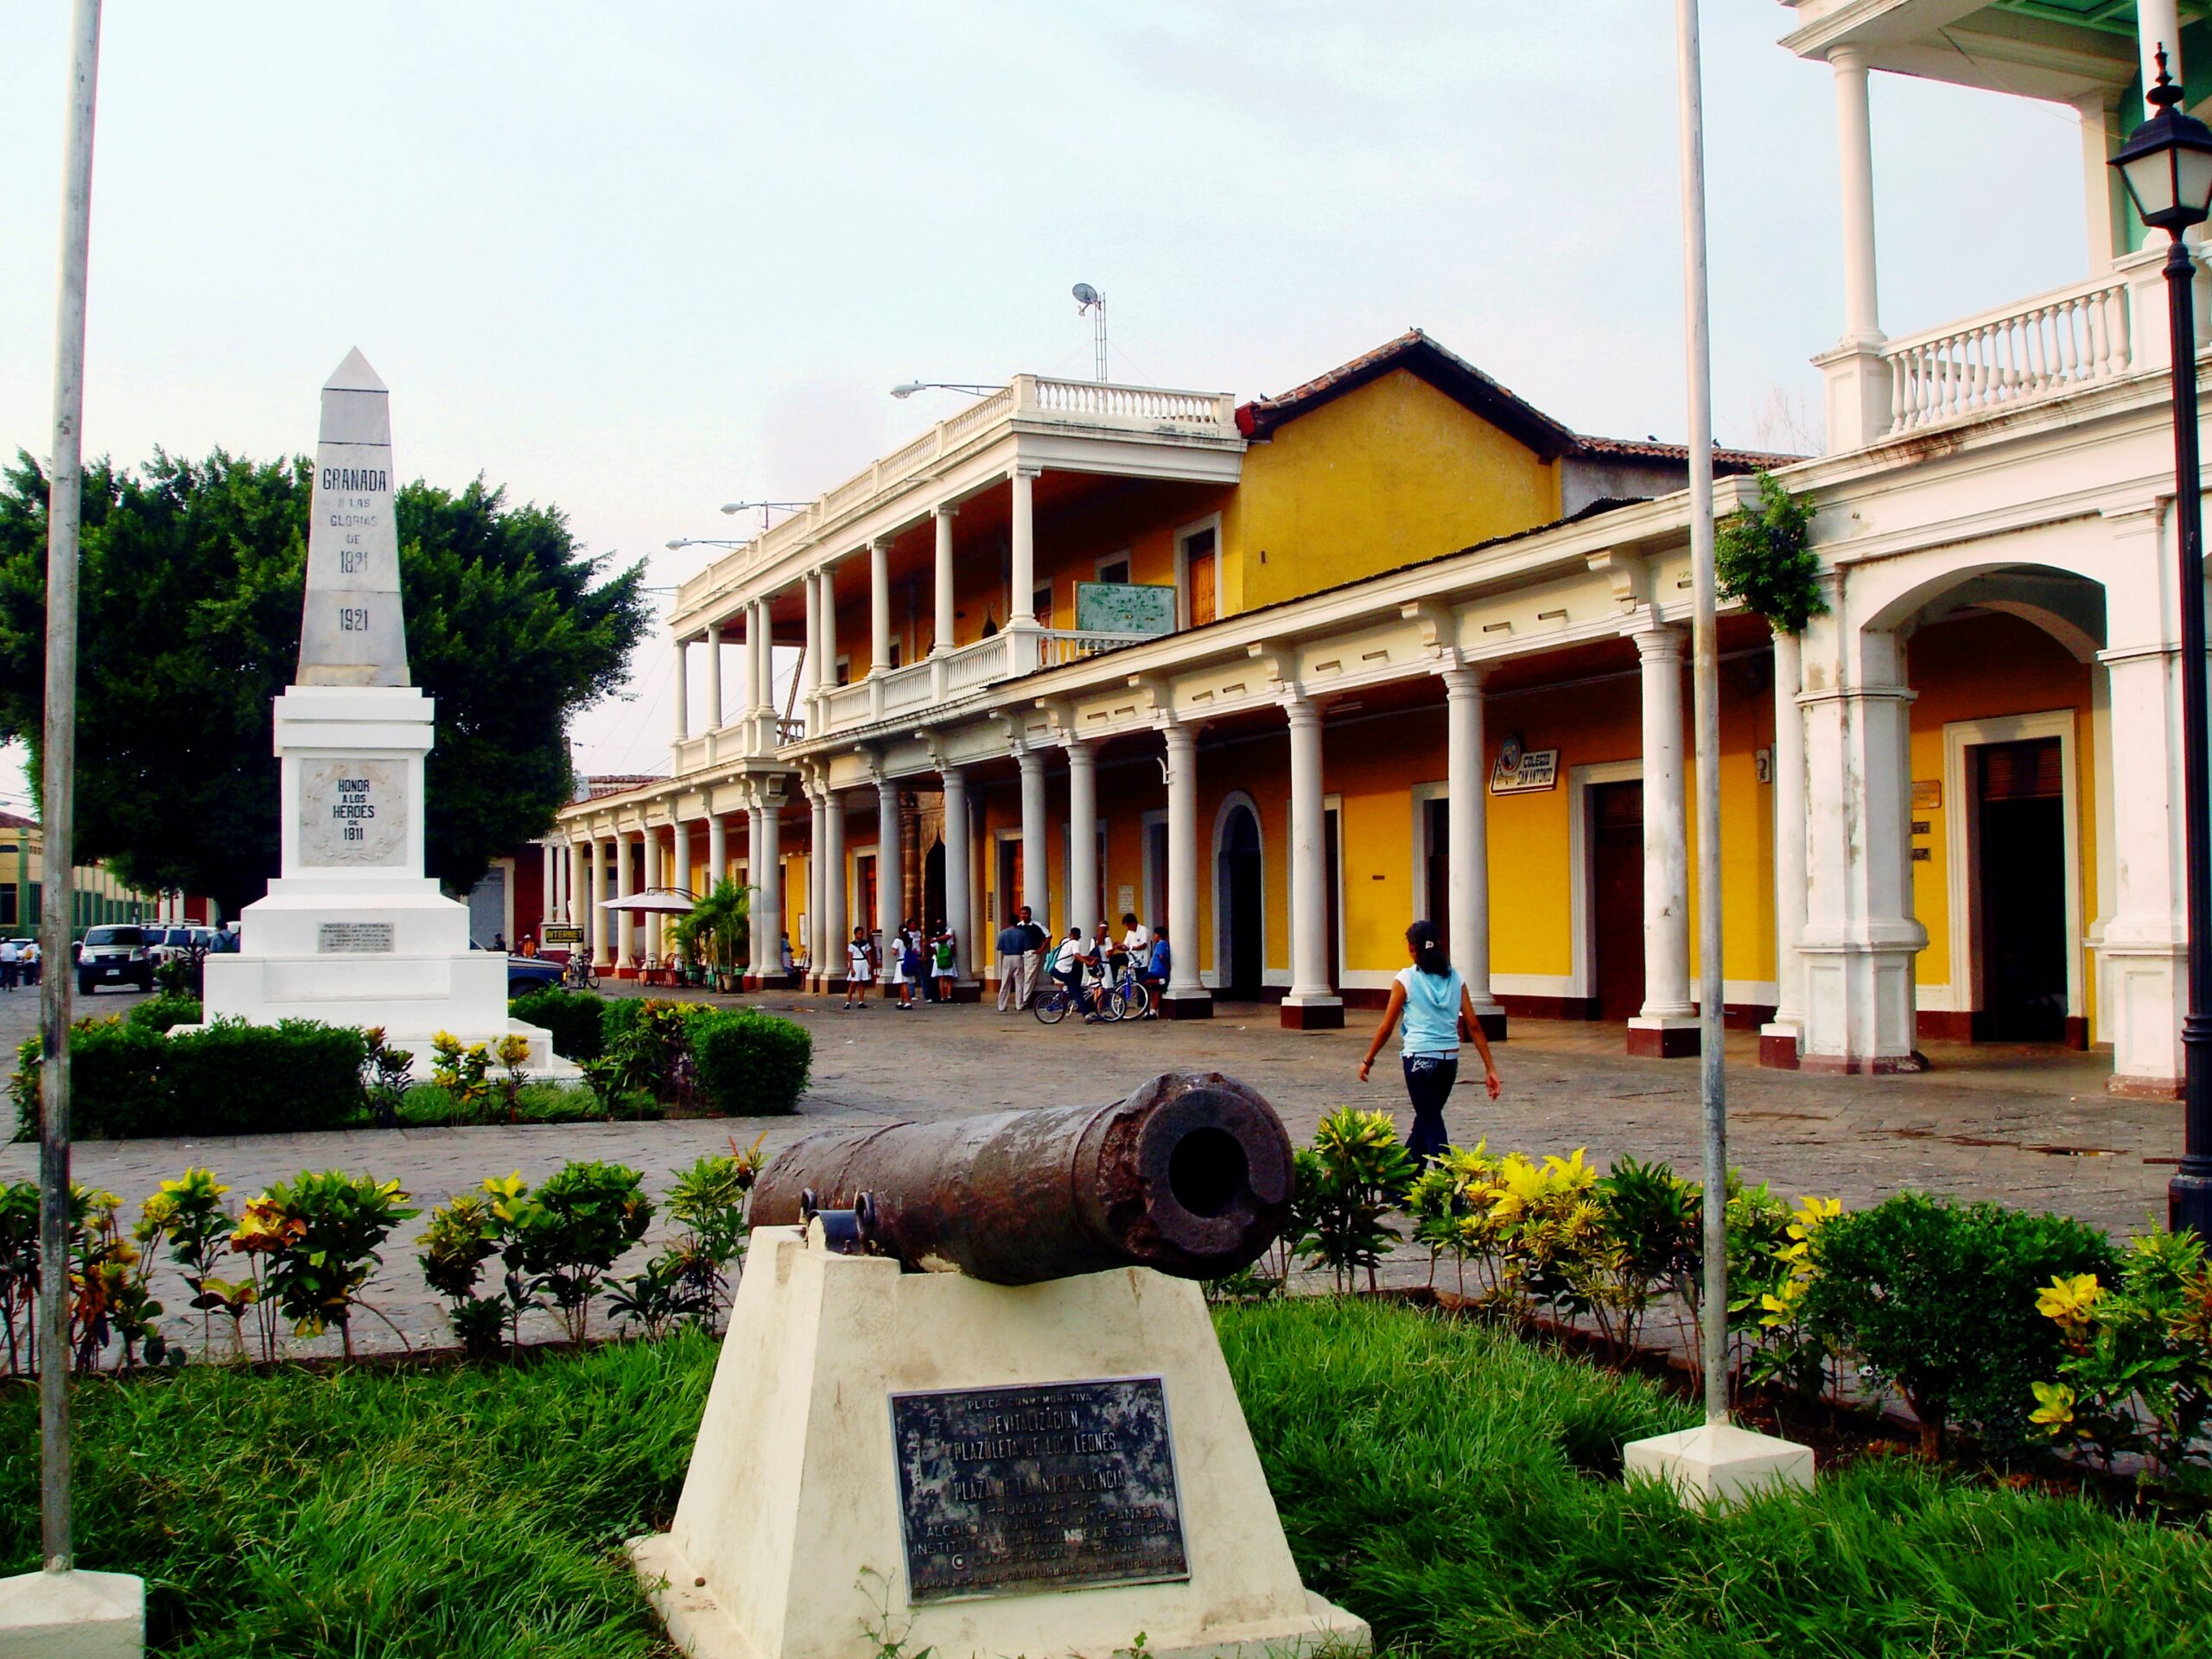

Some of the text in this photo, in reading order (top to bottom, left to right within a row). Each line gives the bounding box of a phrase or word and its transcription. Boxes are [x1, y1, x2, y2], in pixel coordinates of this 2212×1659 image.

[323, 468, 386, 492] GRANADA
[349, 499, 371, 508] LAS
[330, 515, 378, 527] GLORIAS
[346, 535, 360, 544] DE
[340, 608, 369, 632] 1921
[1523, 753, 1551, 768] COLEGIO
[338, 779, 370, 792] HONOR
[342, 795, 366, 804] A LOS
[333, 805, 375, 819] HEROES
[344, 828, 364, 841] 1811
[545, 930, 583, 939] INTERNET
[967, 1398, 1001, 1410] PLACA
[1025, 1438, 1039, 1456] DE
[1046, 1435, 1067, 1454] LOS
[1073, 1431, 1116, 1453] LEONES
[953, 1479, 991, 1501] PLAZA
